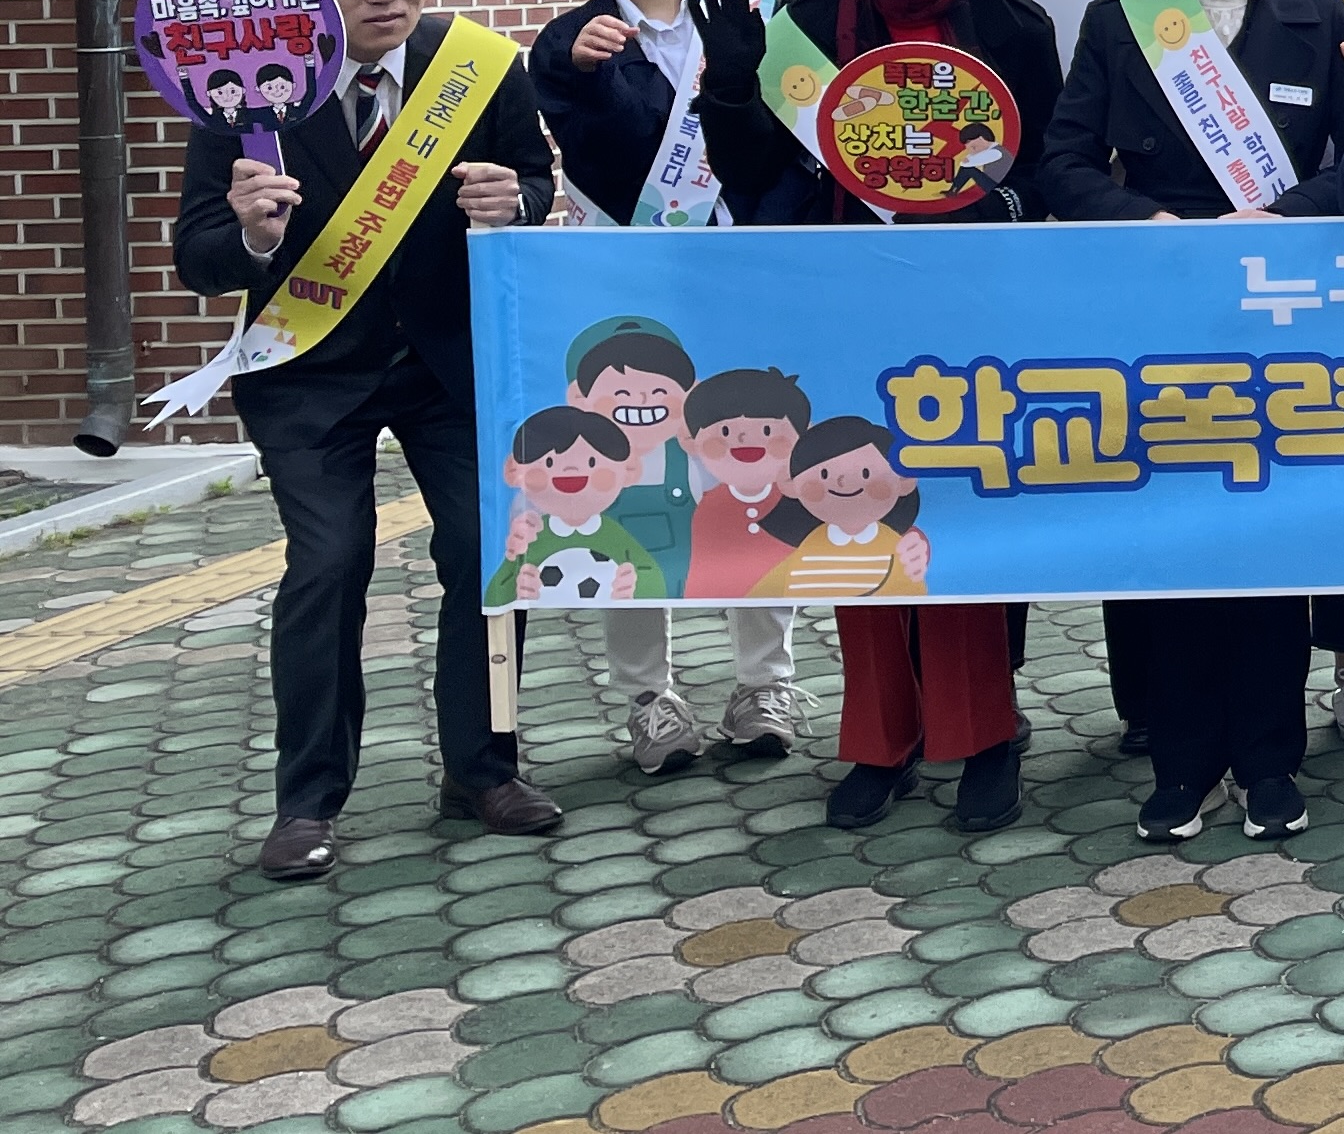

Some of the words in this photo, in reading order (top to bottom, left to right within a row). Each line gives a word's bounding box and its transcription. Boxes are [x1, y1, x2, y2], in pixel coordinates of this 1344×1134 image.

[163, 14, 317, 65] 친구사랑
[424, 59, 480, 130] 스쿨존
[883, 61, 956, 89] 폭력은
[1189, 44, 1251, 131] 친구사랑
[897, 87, 1002, 121] 한순간,
[406, 128, 439, 159] 내
[838, 122, 933, 156] 상처는
[1171, 70, 1207, 114] 좋은
[1198, 113, 1232, 156] 친구
[1226, 158, 1262, 203] 좋은
[372, 157, 420, 211] 불법
[659, 143, 691, 187] 된다
[854, 155, 954, 189] 영원히
[322, 210, 387, 280] 주정차
[288, 276, 349, 310] OUT
